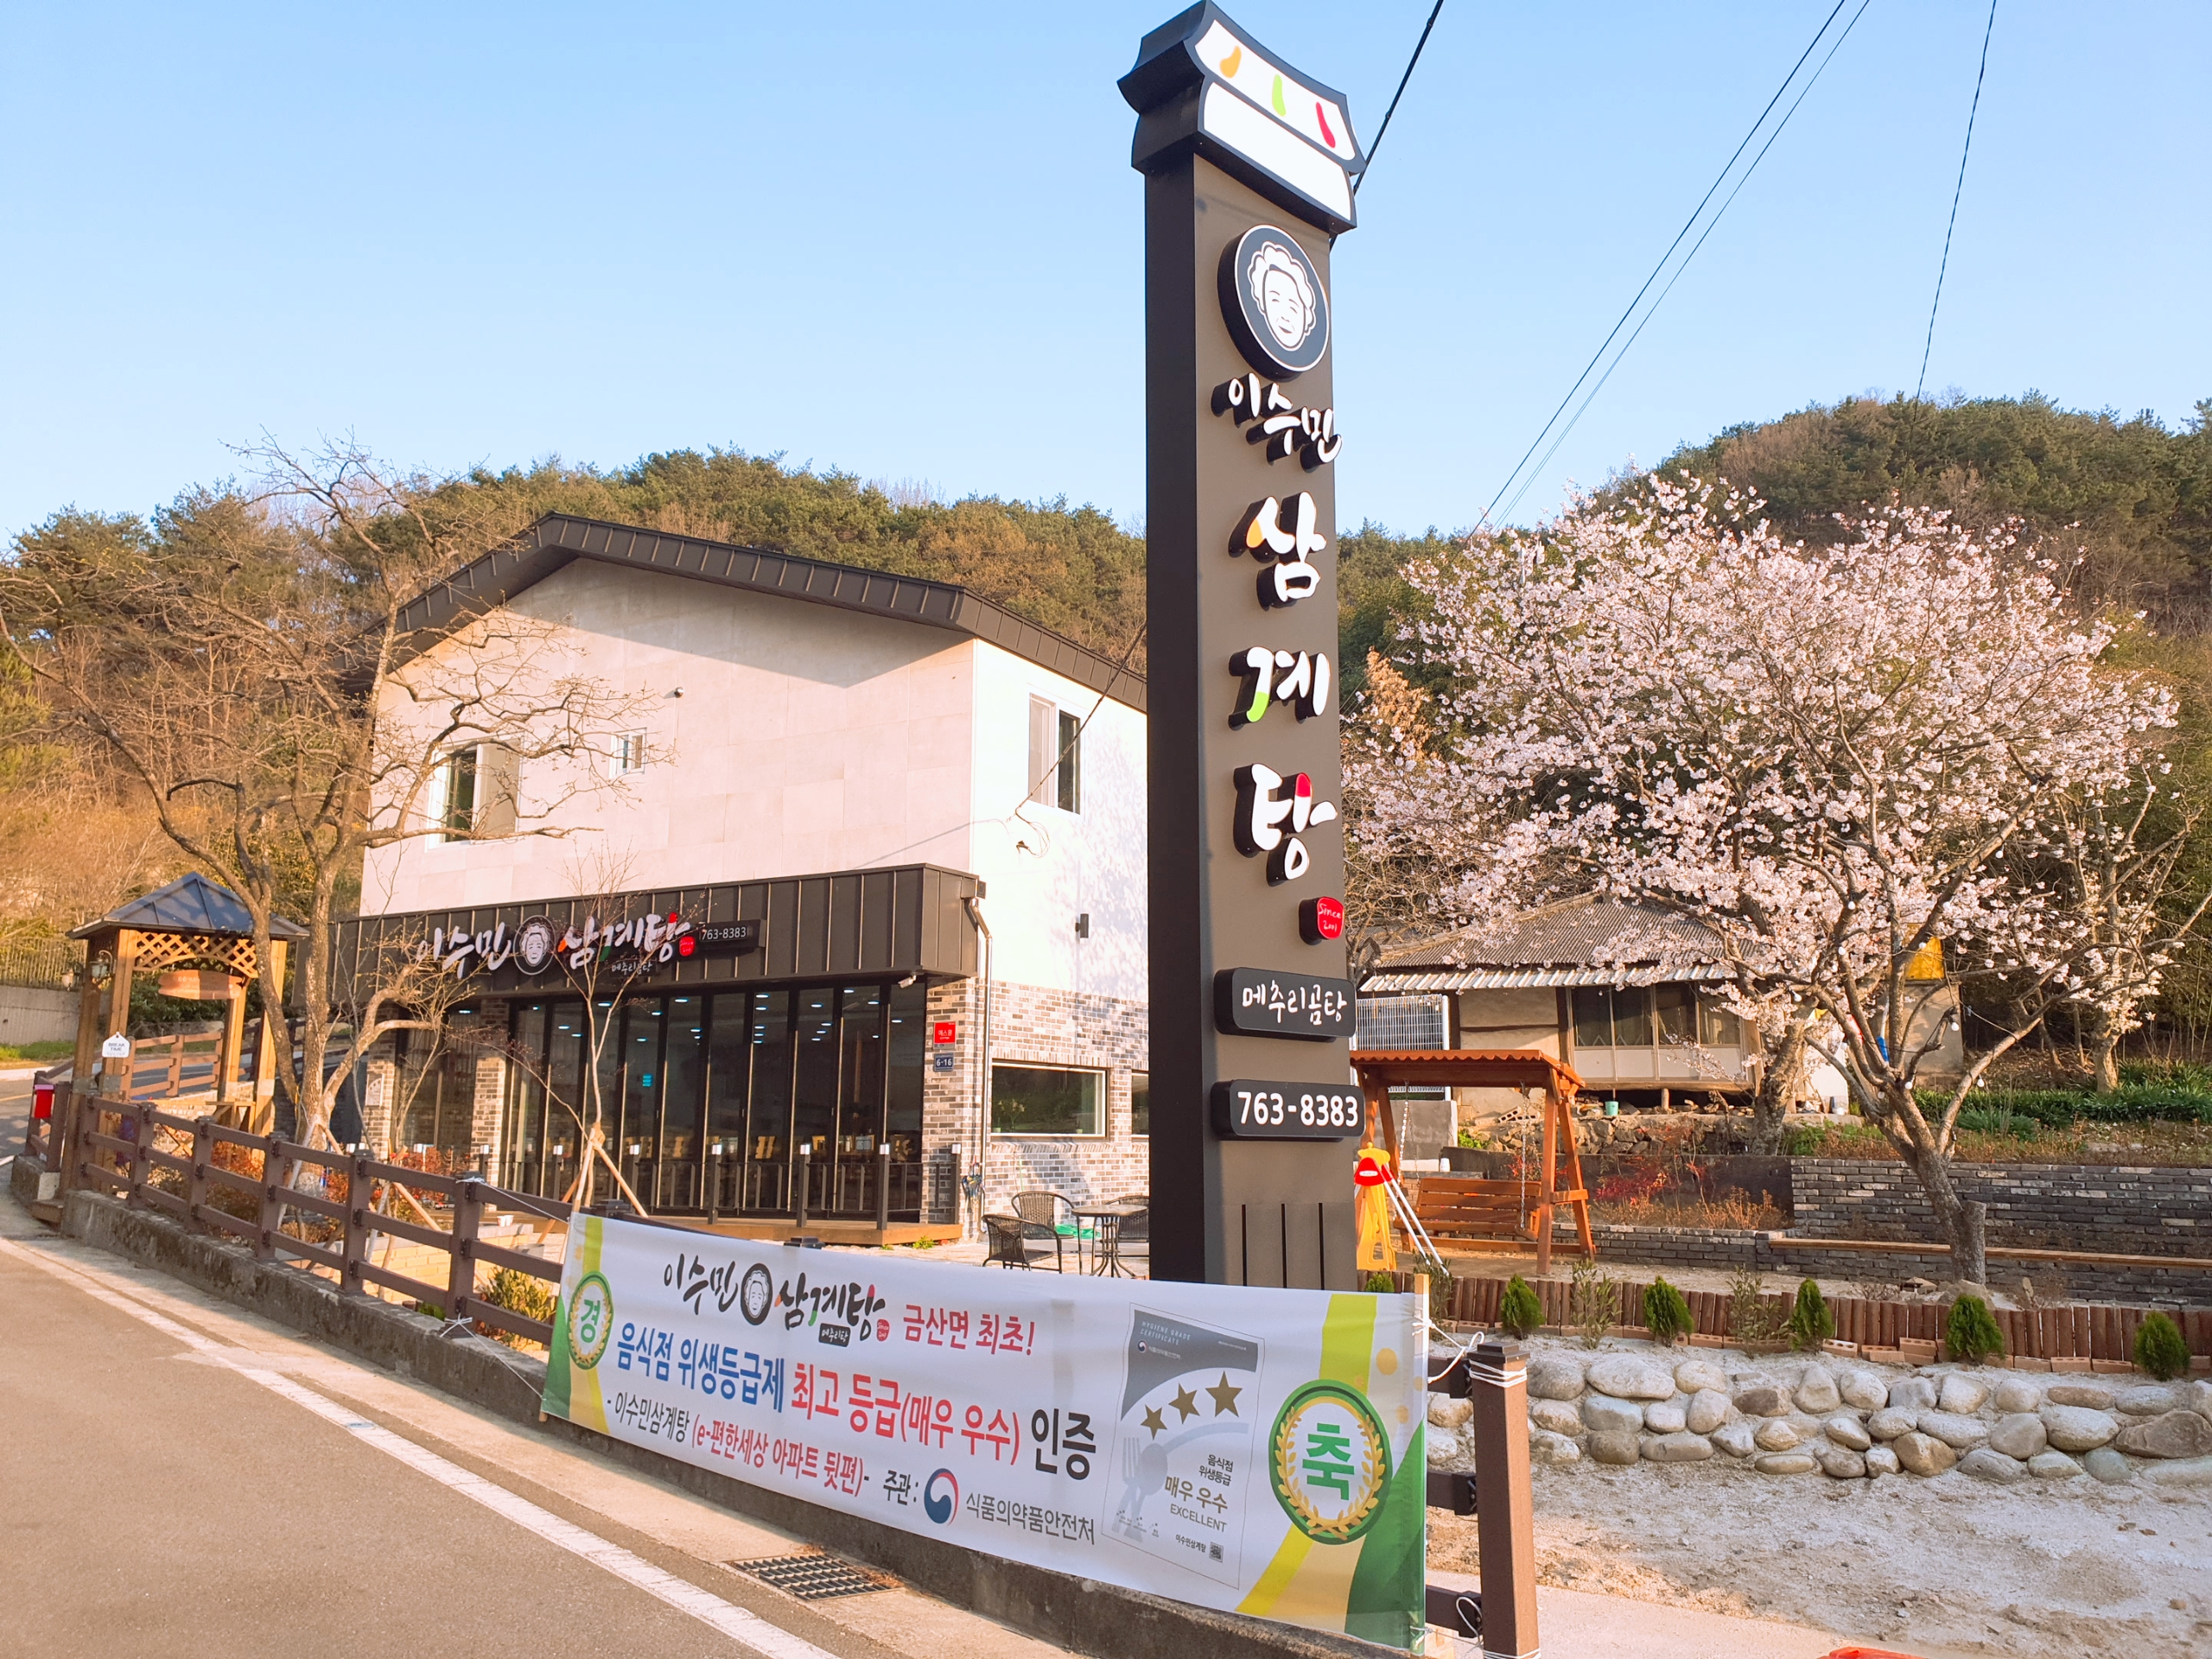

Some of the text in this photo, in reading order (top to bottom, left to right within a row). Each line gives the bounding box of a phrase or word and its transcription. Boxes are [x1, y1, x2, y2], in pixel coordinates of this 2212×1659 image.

[1228, 372, 1342, 464] 이수민
[1245, 491, 1338, 880] 삼계탕
[1319, 903, 1341, 918] Since
[1323, 919, 1338, 932] 2001
[702, 926, 747, 940] 763-8383
[1243, 979, 1348, 1026] 메추리곰탕
[1237, 1091, 1359, 1127] 763-8383
[664, 1253, 886, 1342] 이수민 삼계탕
[581, 1299, 601, 1344] 경
[903, 1304, 1035, 1356] 금산면 최초!
[1141, 1321, 1192, 1341] HYGIENE GRADE
[1141, 1329, 1179, 1346] CERTIFICATE
[617, 1322, 1097, 1481] 음식점 위생등급제 최고 등급(매우 우수) 인증
[614, 1391, 690, 1443] 이수민삼계탕
[691, 1414, 769, 1468] (e-편한세상
[772, 1438, 819, 1479] 아파트
[966, 1491, 1096, 1545] 식품의약품안전처
[1198, 1465, 1232, 1487] 위생등급
[1207, 1453, 1234, 1473] 음식점
[1301, 1421, 1356, 1502] 축
[1164, 1476, 1228, 1514] 매우 우수
[1170, 1503, 1227, 1533] EXCELLENT
